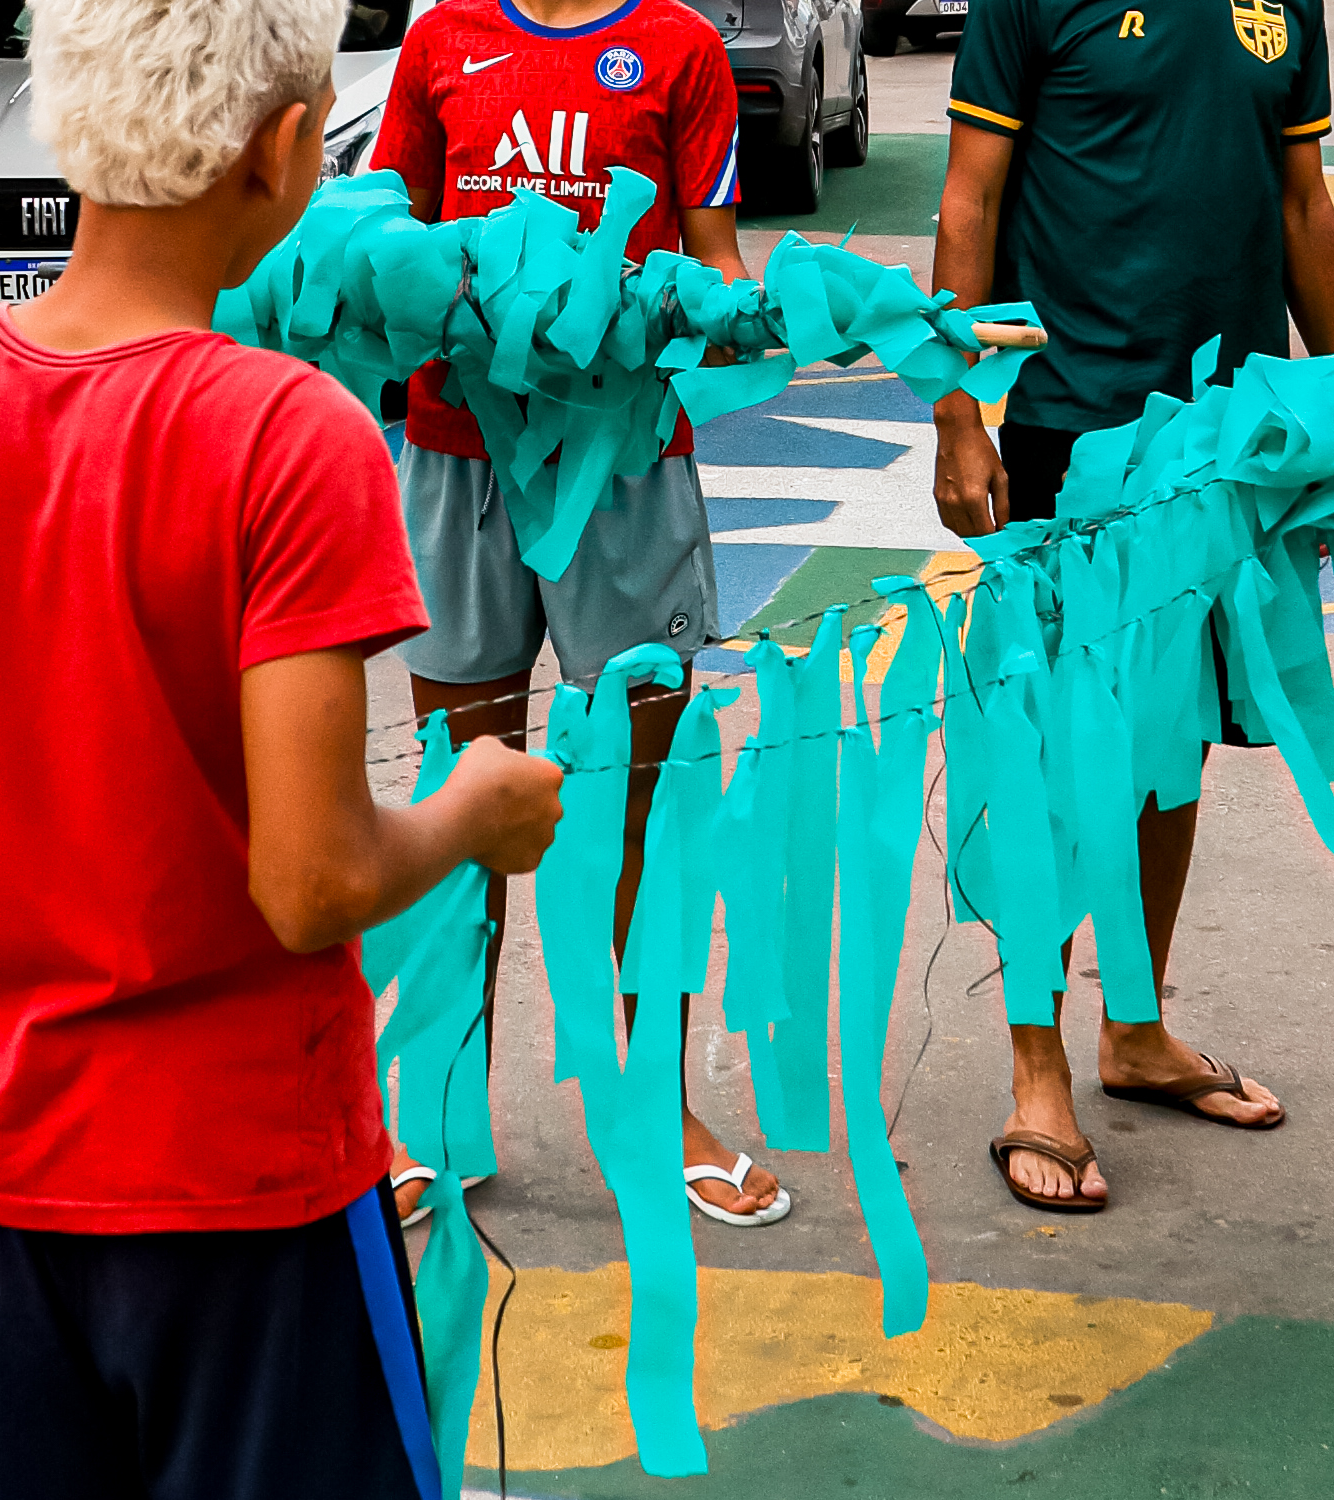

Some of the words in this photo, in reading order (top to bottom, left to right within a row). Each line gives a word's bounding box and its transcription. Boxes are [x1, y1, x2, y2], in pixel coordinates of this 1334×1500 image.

[1235, 21, 1287, 60] CRB
[607, 49, 635, 64] PARIS
[457, 174, 502, 191] ACCOR
[506, 176, 547, 194] LIVE
[21, 197, 70, 236] FIAT
